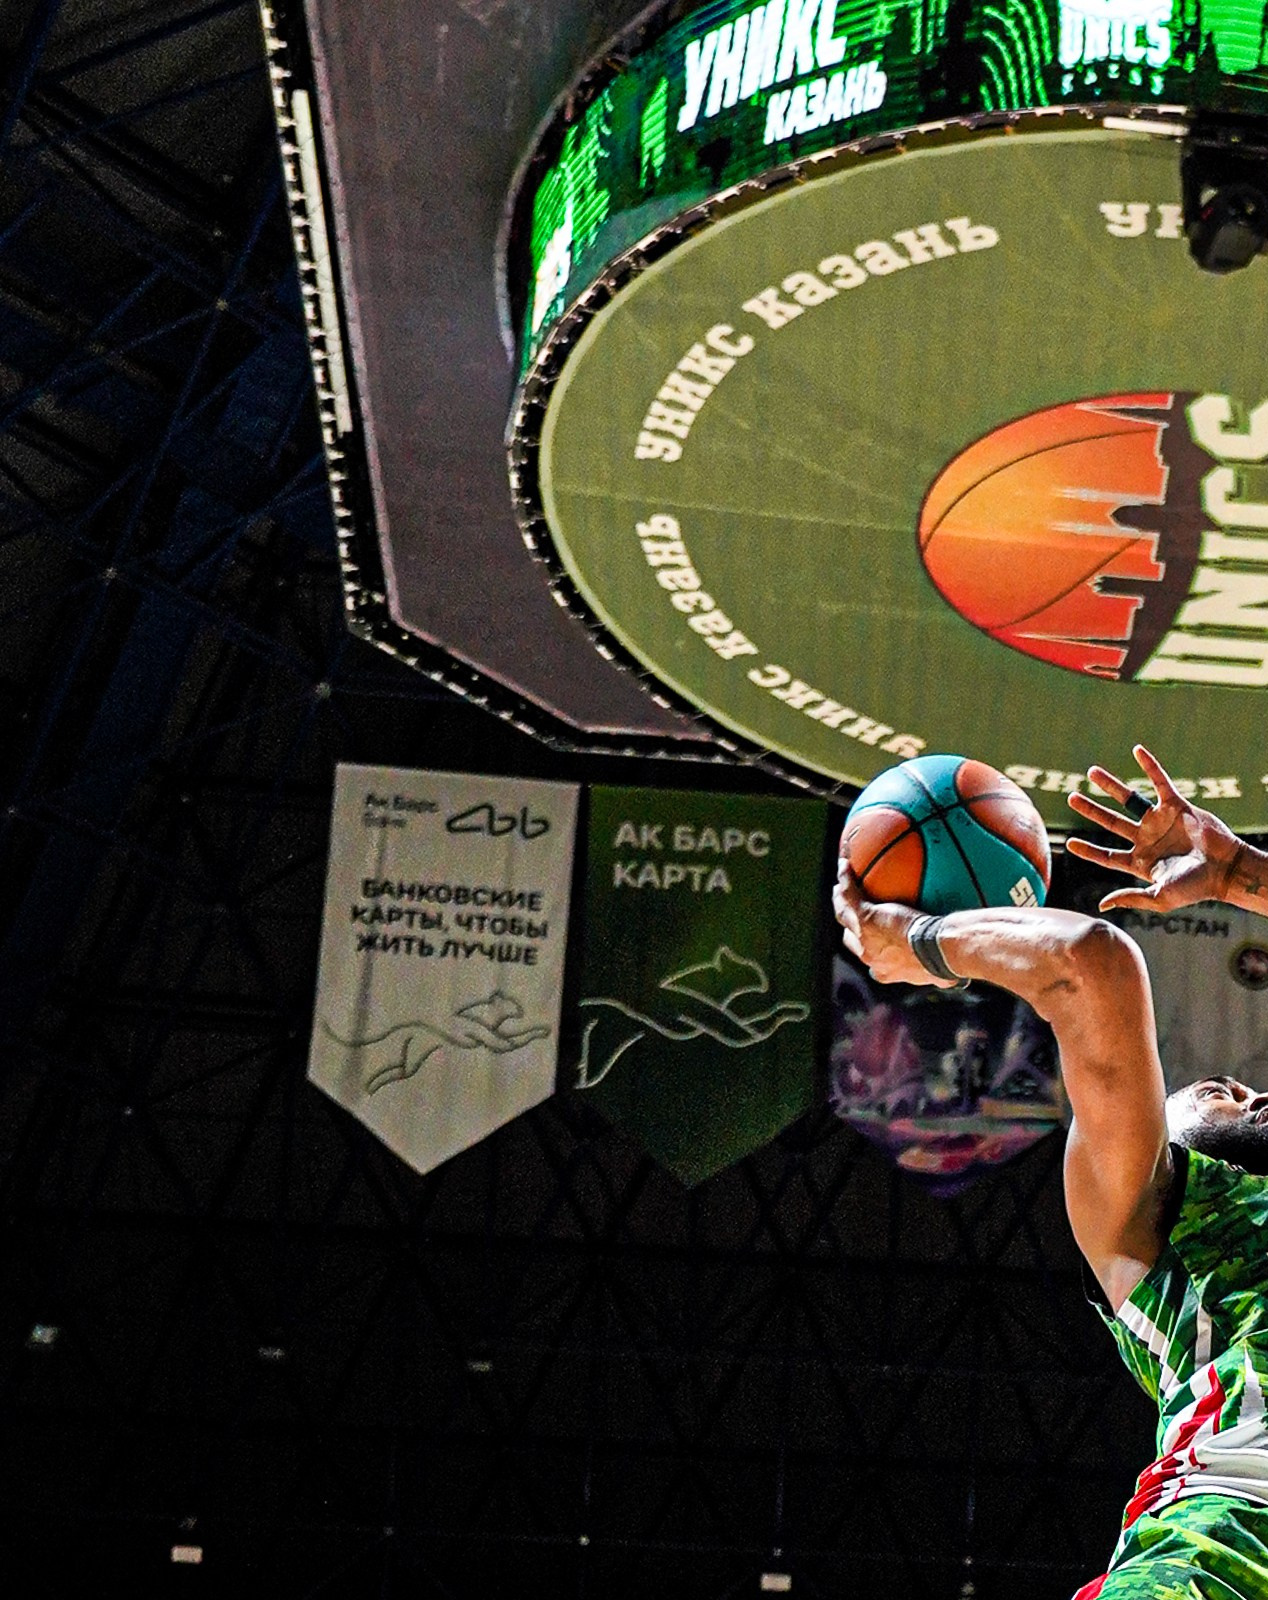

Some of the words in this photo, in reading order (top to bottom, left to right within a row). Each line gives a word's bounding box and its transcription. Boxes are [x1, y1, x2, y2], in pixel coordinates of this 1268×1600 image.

[1059, 5, 1171, 69] UNICS
[677, 0, 847, 132] УНИКС
[764, 60, 888, 145] КАЗАНЬ
[613, 821, 664, 851] АК
[672, 826, 771, 859] БАРС
[361, 878, 544, 913] БАНКОВСКИЕ
[613, 861, 732, 894] КАРТА
[350, 903, 449, 934] КАРТЫ,
[454, 912, 549, 940] ЧТОБЫ
[356, 931, 436, 959] ЖИТЬ
[439, 937, 540, 967] ЛУЧШЕ
